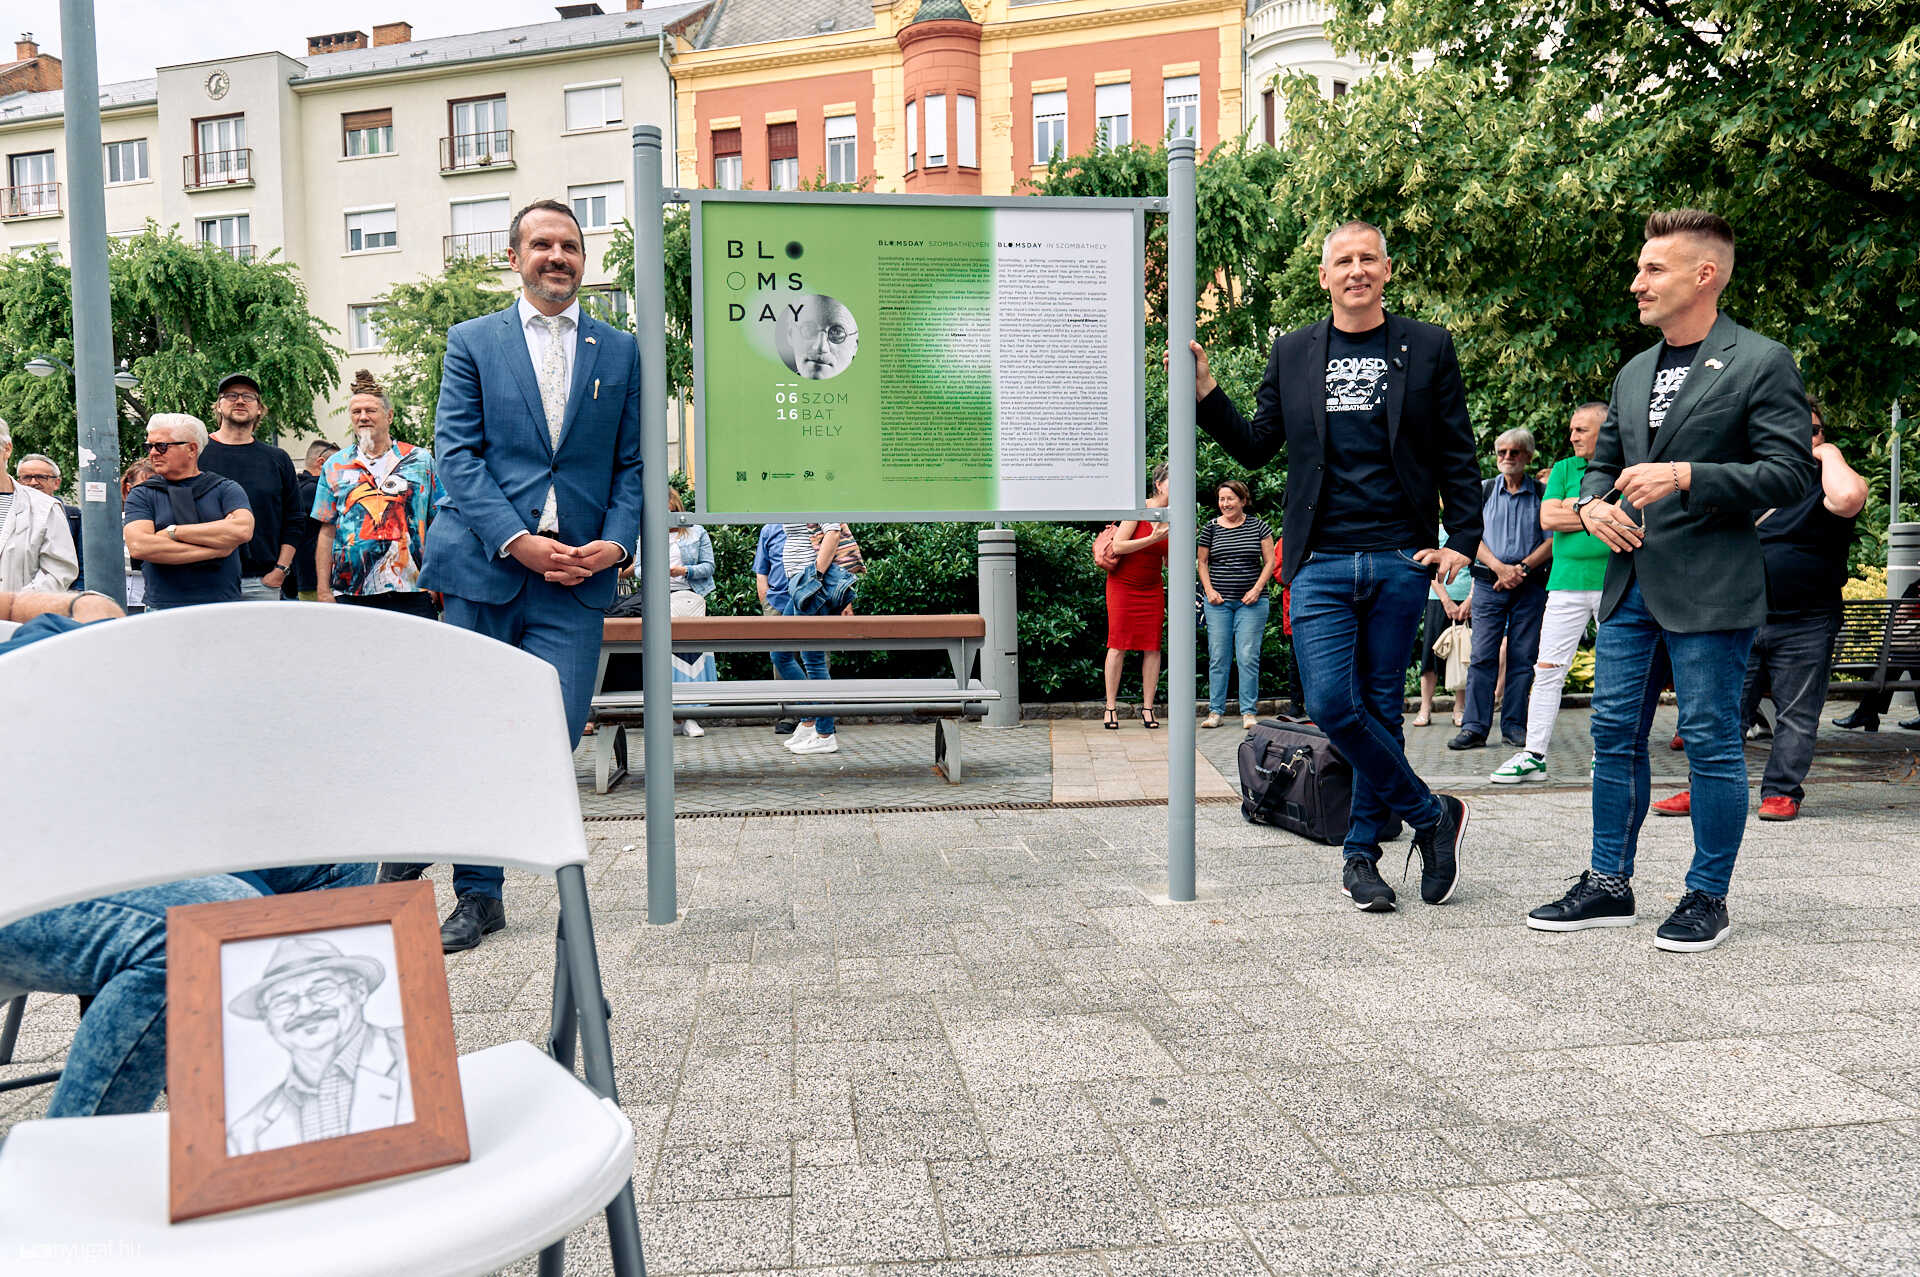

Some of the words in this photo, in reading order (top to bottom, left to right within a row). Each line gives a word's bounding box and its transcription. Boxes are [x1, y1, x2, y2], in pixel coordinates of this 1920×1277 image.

[726, 272, 803, 291] OMS
[728, 304, 804, 322] DAY
[776, 392, 798, 404] 06
[801, 393, 848, 405] SZOM
[776, 409, 799, 420] 16
[802, 409, 833, 420] BAT
[802, 425, 843, 437] HELY
